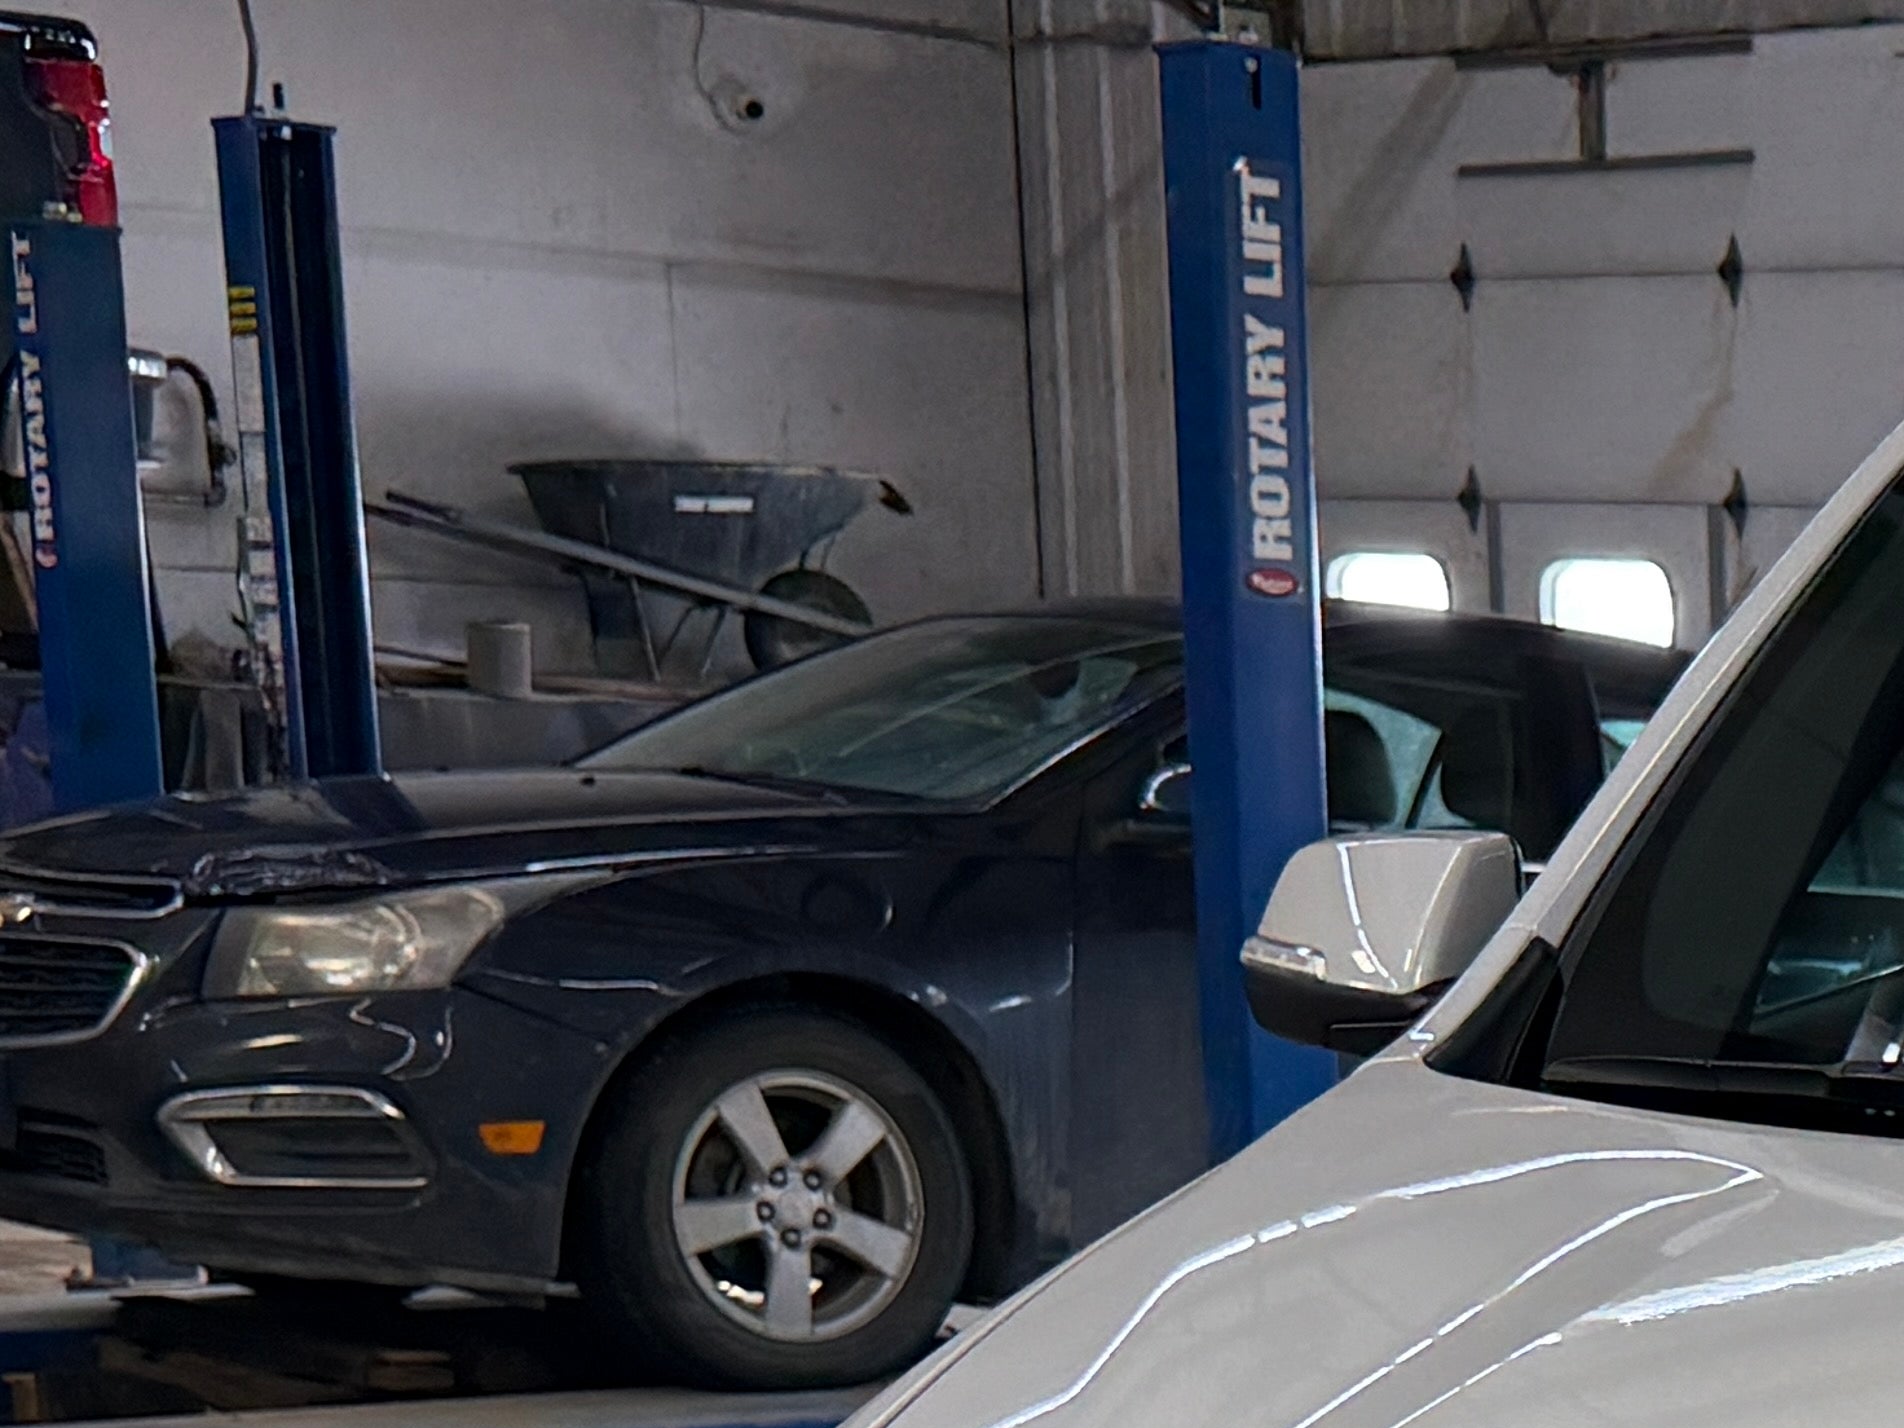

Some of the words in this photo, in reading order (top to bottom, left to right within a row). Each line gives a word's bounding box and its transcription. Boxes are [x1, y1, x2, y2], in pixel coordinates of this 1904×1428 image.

[11, 230, 37, 333] LIFT
[1240, 160, 1284, 299] LIFT
[20, 349, 54, 541] ROTARY
[1245, 313, 1293, 560] ROTARY
